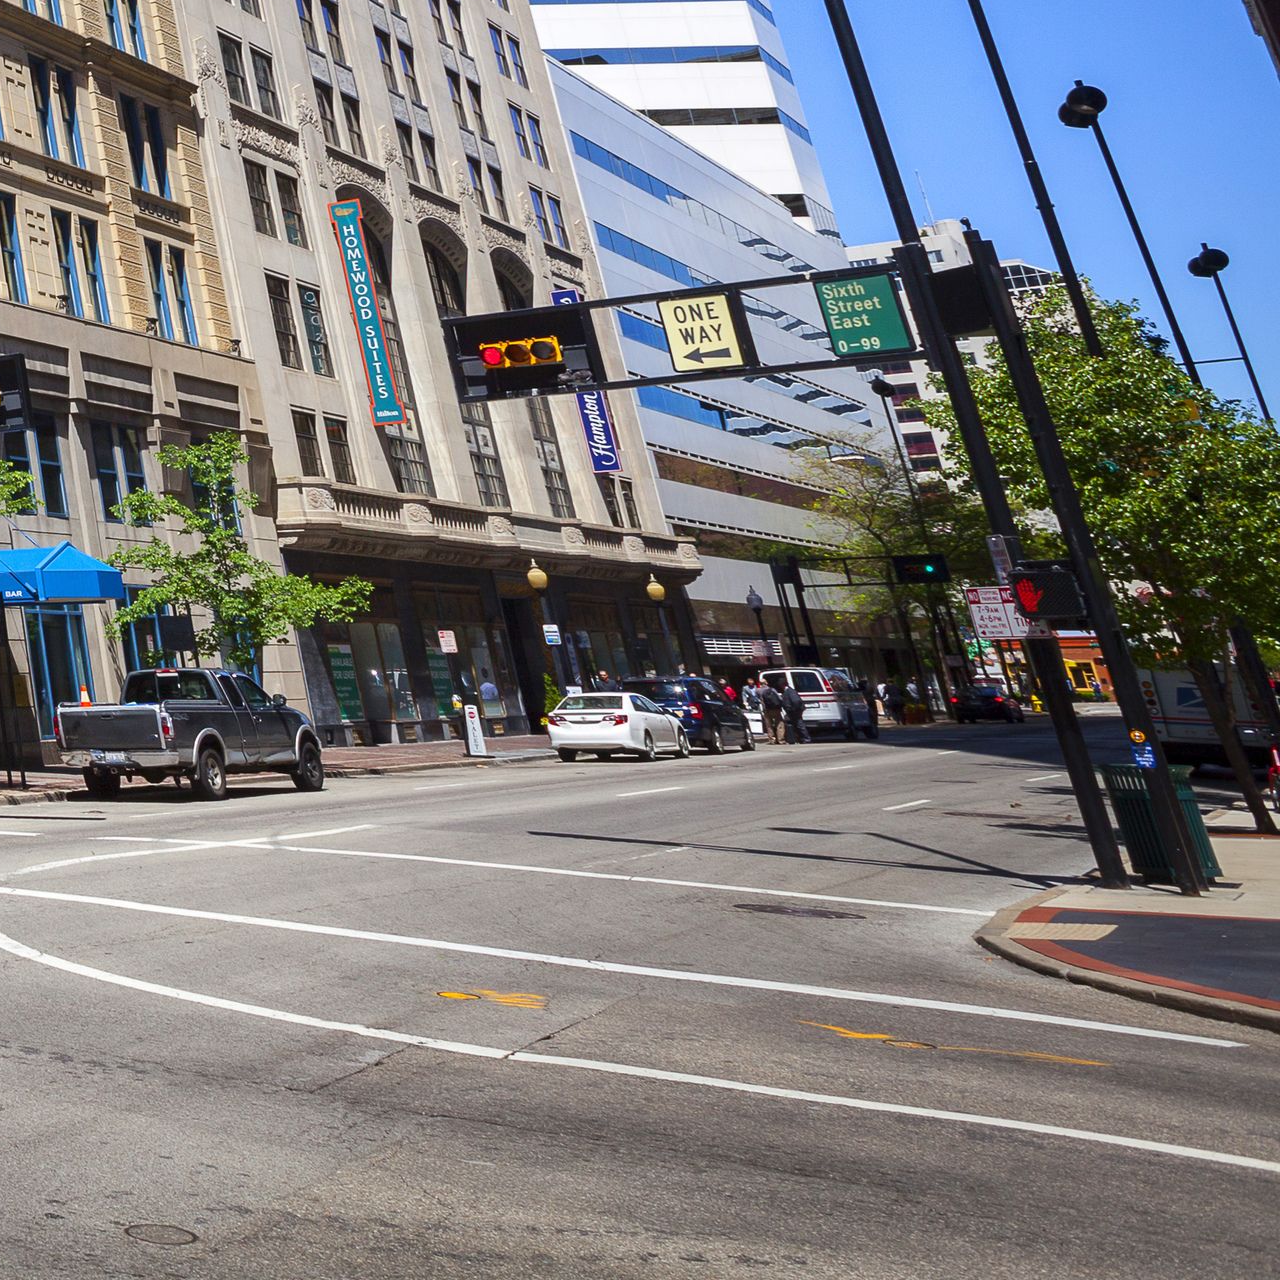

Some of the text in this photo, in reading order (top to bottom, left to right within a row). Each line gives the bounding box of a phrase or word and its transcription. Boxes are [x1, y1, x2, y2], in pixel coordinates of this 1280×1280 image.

[343, 224, 372, 320] HOMEWOOD
[821, 282, 865, 299] Sixth
[673, 302, 720, 324] ONE
[827, 296, 882, 314] Street
[830, 314, 871, 329] East
[678, 323, 722, 345] WAY
[838, 337, 881, 352] 0-99
[365, 325, 389, 399] SUITES
[376, 410, 398, 418] Hilton
[583, 390, 616, 466] Hampton
[5, 590, 23, 598] BAR
